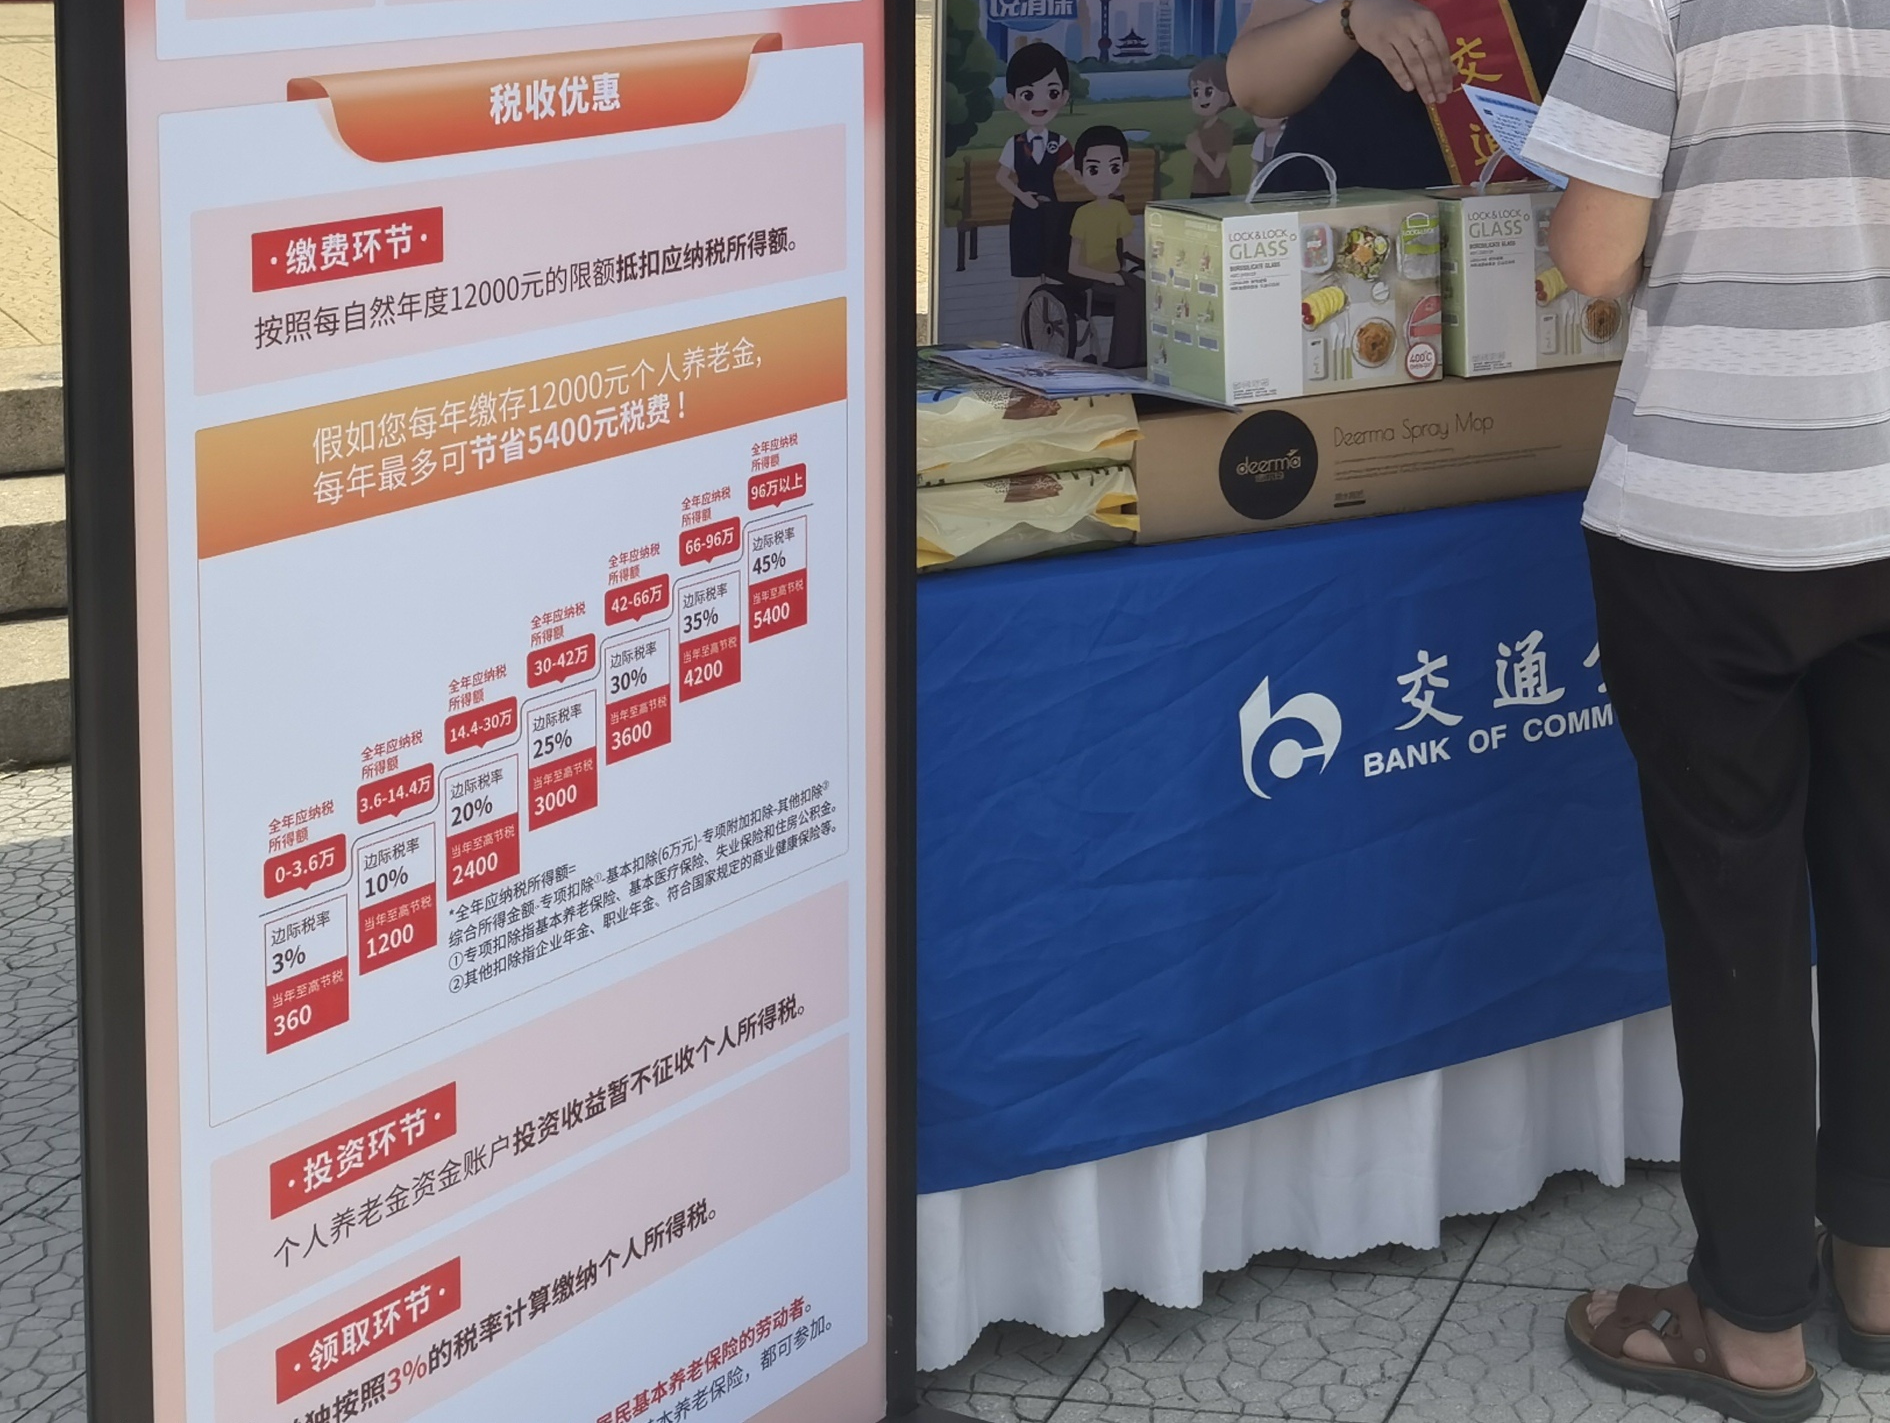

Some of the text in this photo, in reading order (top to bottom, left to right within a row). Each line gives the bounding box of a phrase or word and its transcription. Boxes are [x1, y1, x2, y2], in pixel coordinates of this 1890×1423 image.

[488, 72, 622, 125] 税收优惠
[1467, 208, 1522, 221] LOCK&LOCK
[1468, 219, 1523, 239] GLASS
[1228, 228, 1288, 243] LOCK&LOCK
[1229, 239, 1289, 260] GLASS
[253, 225, 797, 351] 按照每自然年度12000元的限额抵扣应纳税所得额。
[751, 432, 799, 458] 全年应纳税
[1333, 411, 1494, 448] Deerma Spray Mop
[751, 453, 780, 472] 所得额
[750, 472, 804, 501] 96万以上
[684, 526, 735, 556] 66-96万
[752, 526, 796, 553] 边际税率
[752, 550, 787, 577] 45%
[611, 584, 663, 614] 42-66万
[752, 578, 805, 606] 当年至高节税
[683, 607, 719, 635] 35%
[753, 602, 791, 629] 5400
[533, 643, 588, 677] 30-42万
[683, 659, 724, 689] 4200
[447, 664, 508, 695] 全年应纳税
[610, 666, 648, 696] 30%
[1395, 629, 1609, 731] 交通
[448, 686, 485, 712] 所得额
[449, 709, 513, 744] 14.4-30万
[611, 720, 652, 751] 3600
[1363, 702, 1614, 778] BANK OF COMM
[532, 729, 573, 760] 25%
[359, 775, 431, 813] 3.6-14.4万
[450, 768, 504, 802] 边际税率
[534, 784, 578, 817] 3000
[268, 799, 334, 835] 全年应纳税
[450, 795, 493, 829] 20%
[268, 828, 309, 854] 所得额
[450, 824, 516, 860] 当年至高节税
[274, 847, 335, 883] 0-3.6万
[451, 851, 499, 887] 2400
[364, 866, 409, 899] 10%
[270, 909, 331, 947] 边际税率
[365, 922, 414, 960] 1200
[271, 945, 306, 976] 3%
[272, 968, 345, 1008] 当年至高节税
[273, 1004, 312, 1037] 360
[273, 992, 806, 1269] 个人养老金资金账户投资收益暂不征收个人所得税。
[293, 1197, 718, 1423] 独按照3%的税率计算缴纳个人所得税。
